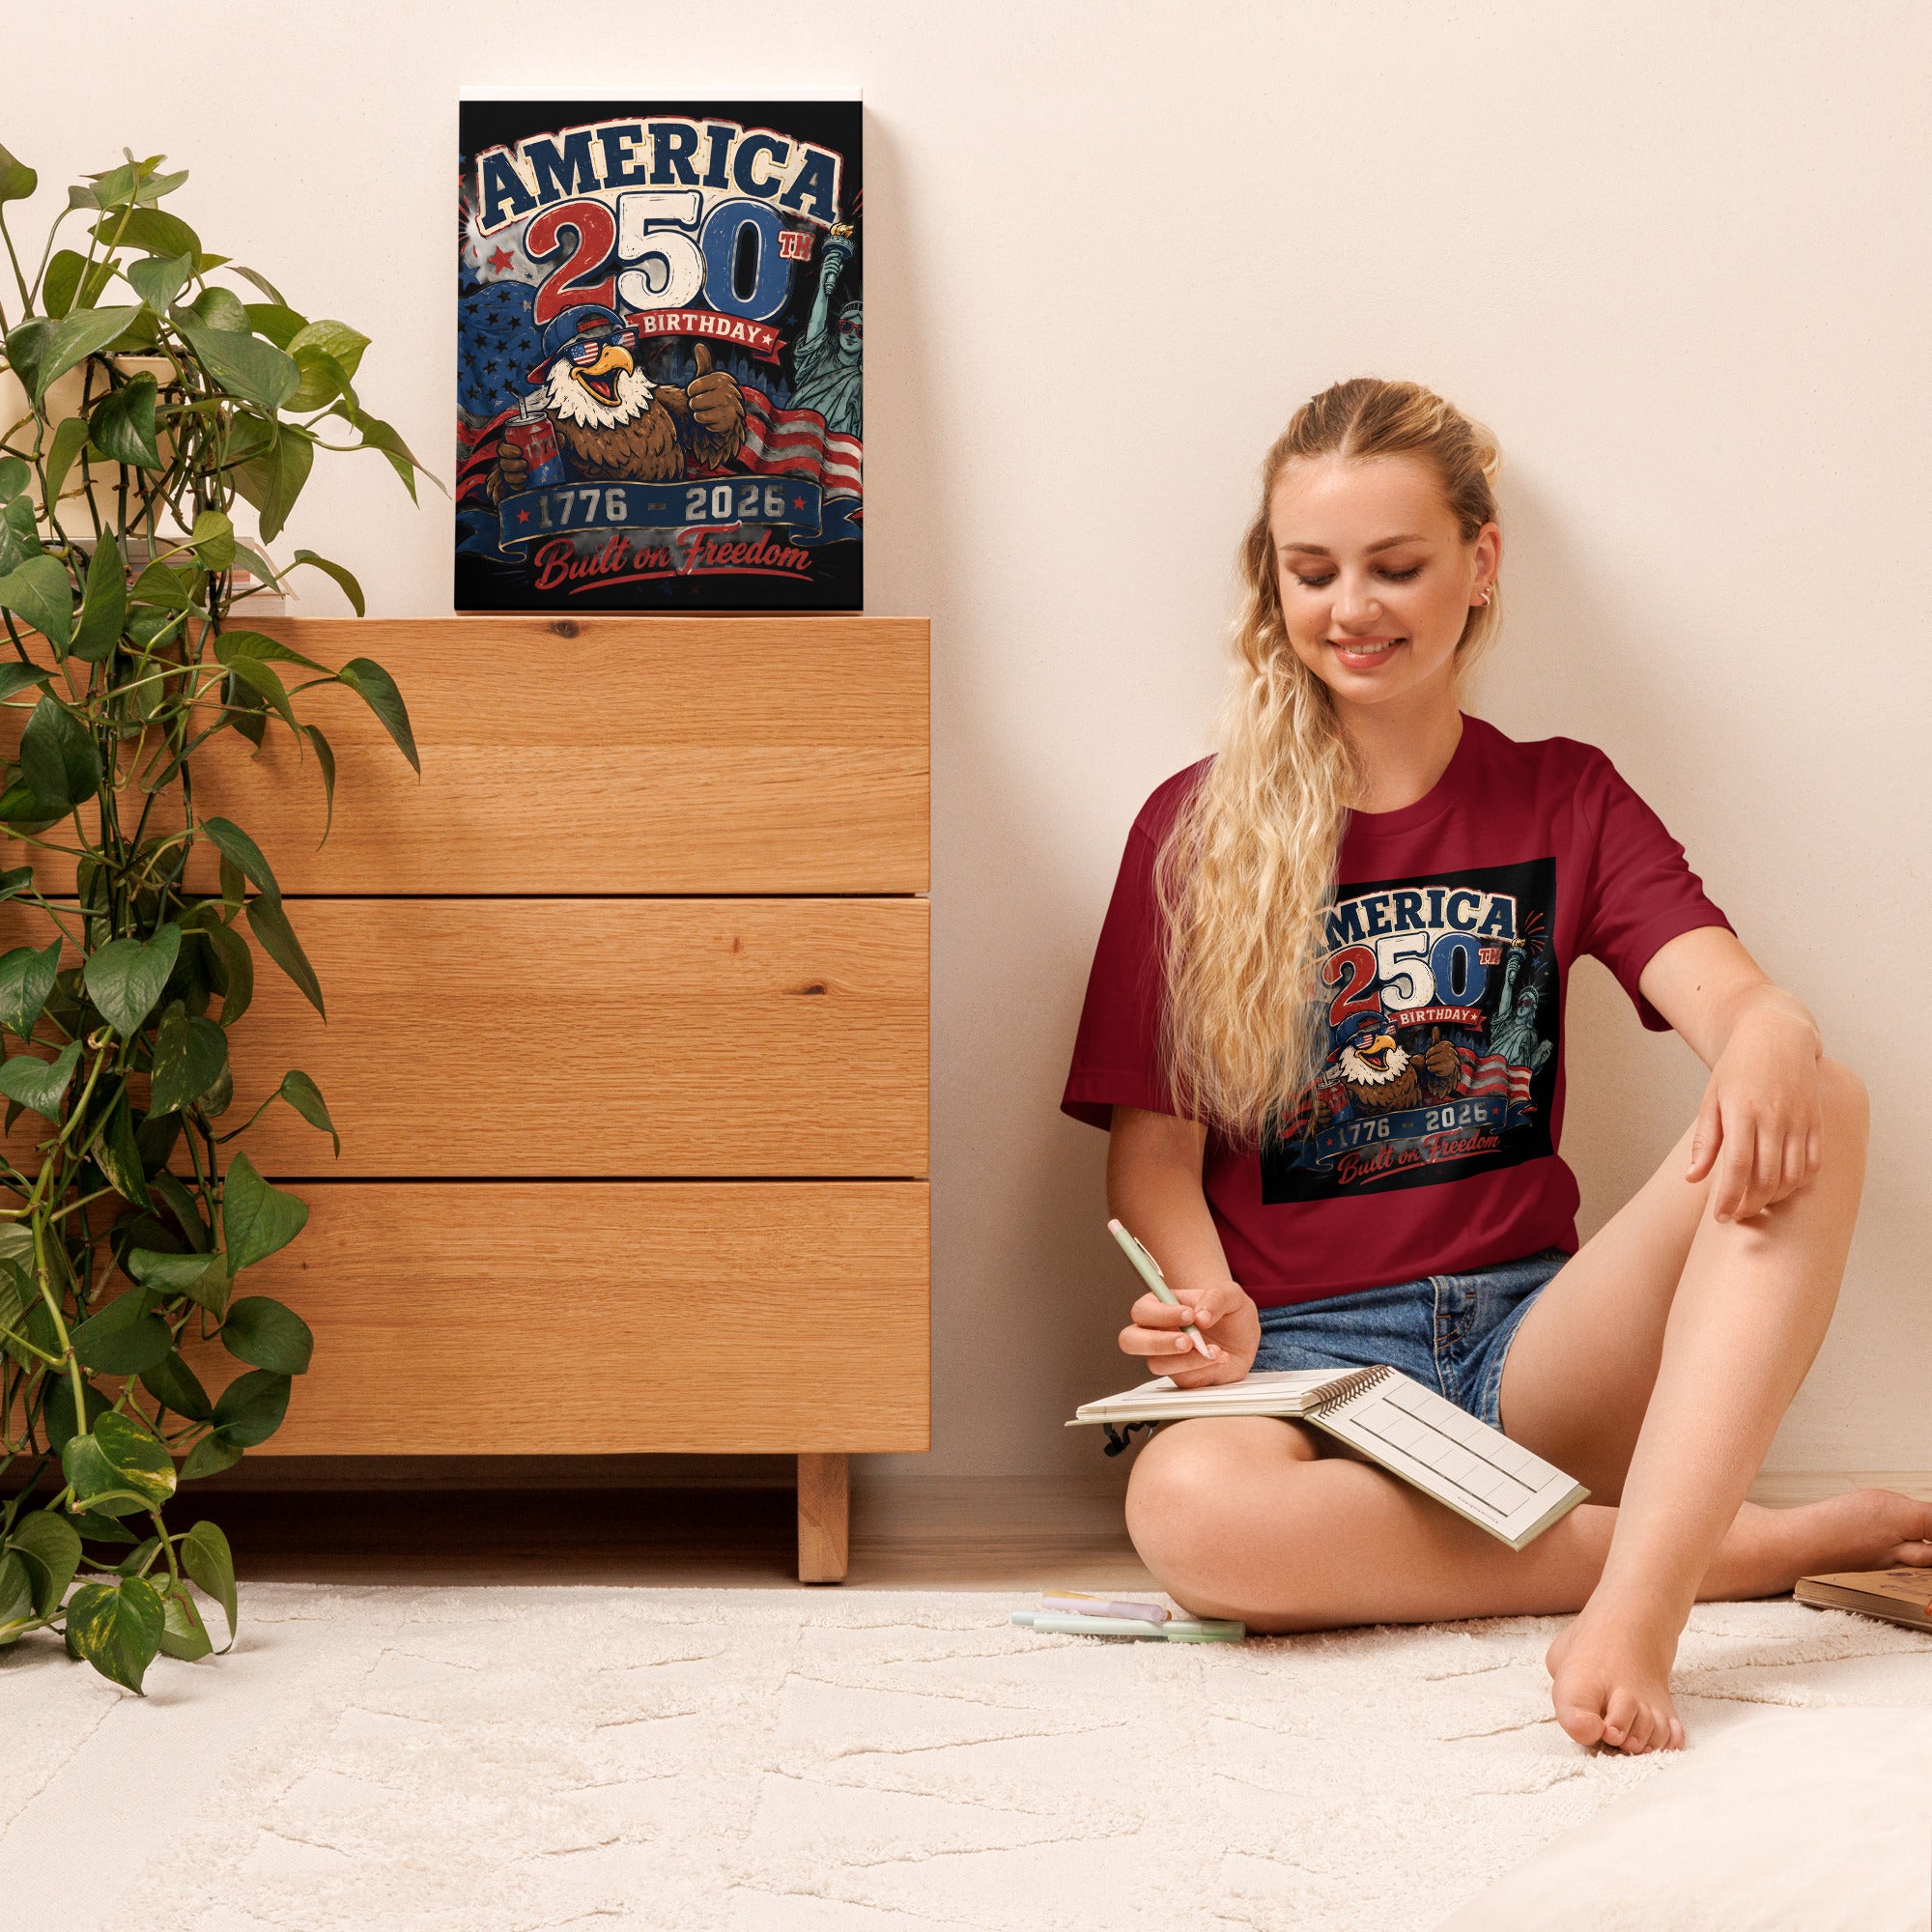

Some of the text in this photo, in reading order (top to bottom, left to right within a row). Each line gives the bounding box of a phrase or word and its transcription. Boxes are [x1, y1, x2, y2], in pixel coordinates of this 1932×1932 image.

[477, 120, 840, 228] AMERICA
[642, 313, 761, 345] BIRTHDAY
[536, 487, 628, 528] 1776
[685, 485, 785, 522] 2026
[534, 520, 813, 590] Built on Freedom
[1313, 888, 1517, 954] MERICA
[1400, 1009, 1469, 1026] BIRTHDAY
[1338, 1117, 1390, 1149] 1776
[1425, 1101, 1488, 1132] 2026
[1337, 1125, 1499, 1185] Built on Freedom
